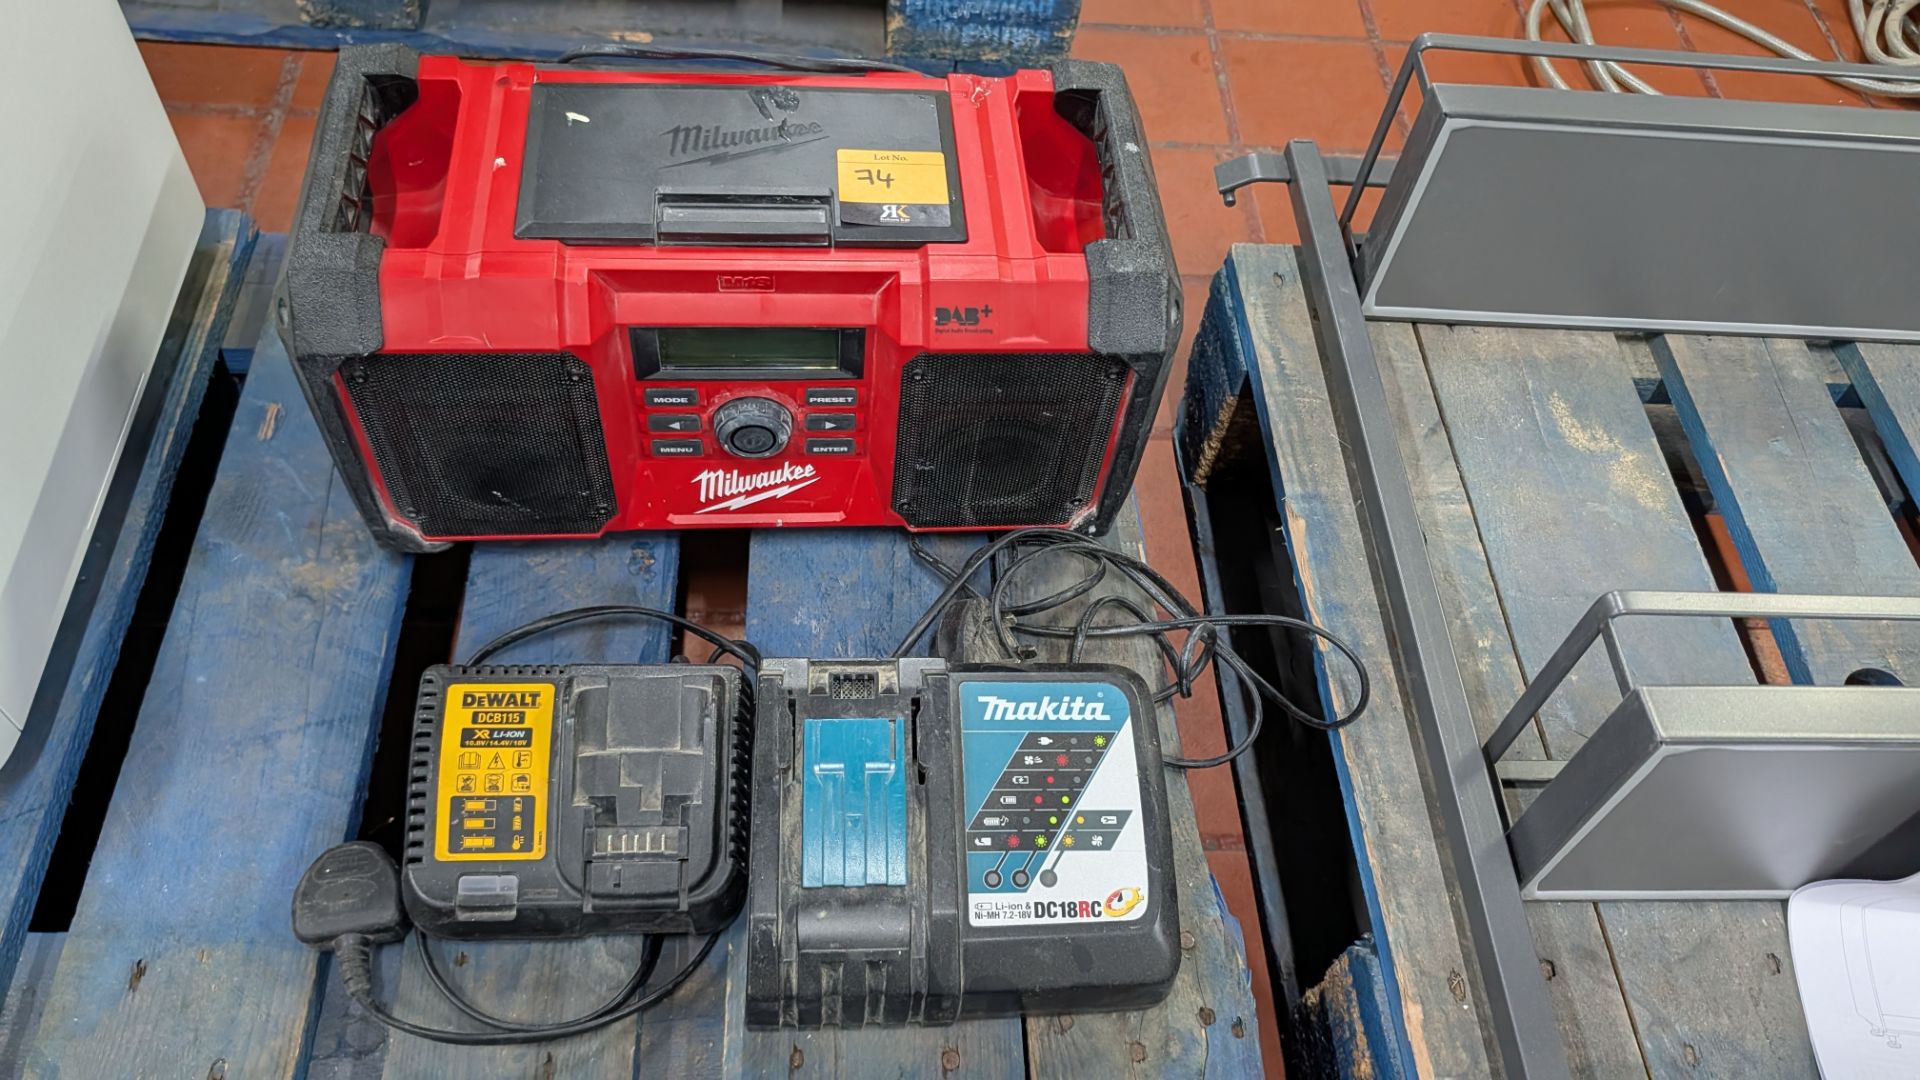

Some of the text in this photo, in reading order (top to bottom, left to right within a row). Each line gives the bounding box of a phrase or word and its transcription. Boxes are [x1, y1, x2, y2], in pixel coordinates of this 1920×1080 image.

[892, 154, 909, 162] No.
[854, 169, 895, 189] 74
[690, 461, 817, 503] Milwaukee
[477, 713, 520, 724] DCB115
[473, 730, 491, 739] XR
[995, 902, 1032, 910] Li-ion &
[1034, 900, 1103, 919] DC18RC
[974, 910, 1032, 920] Ni-MH 7.2-18V
